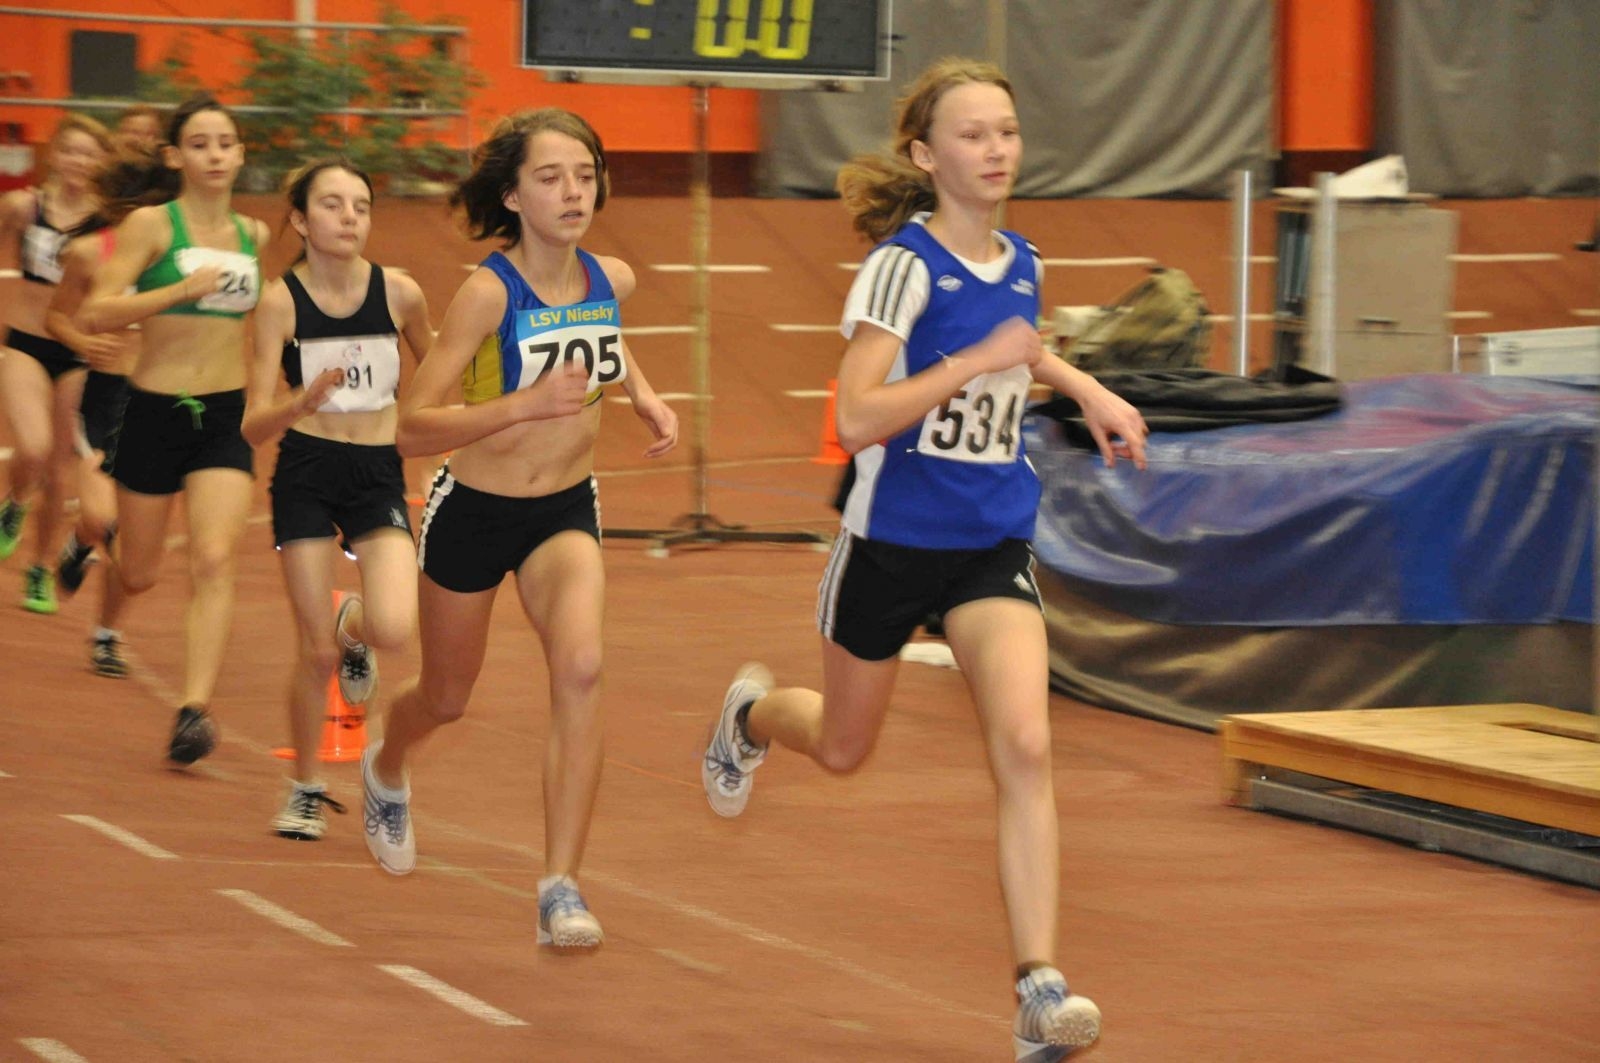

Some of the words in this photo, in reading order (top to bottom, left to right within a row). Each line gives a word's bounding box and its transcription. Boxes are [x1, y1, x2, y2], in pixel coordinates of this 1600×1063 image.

[529, 310, 561, 328] LSV
[566, 306, 614, 323] Niesky
[528, 334, 621, 388] 705
[930, 390, 1017, 455] 534
